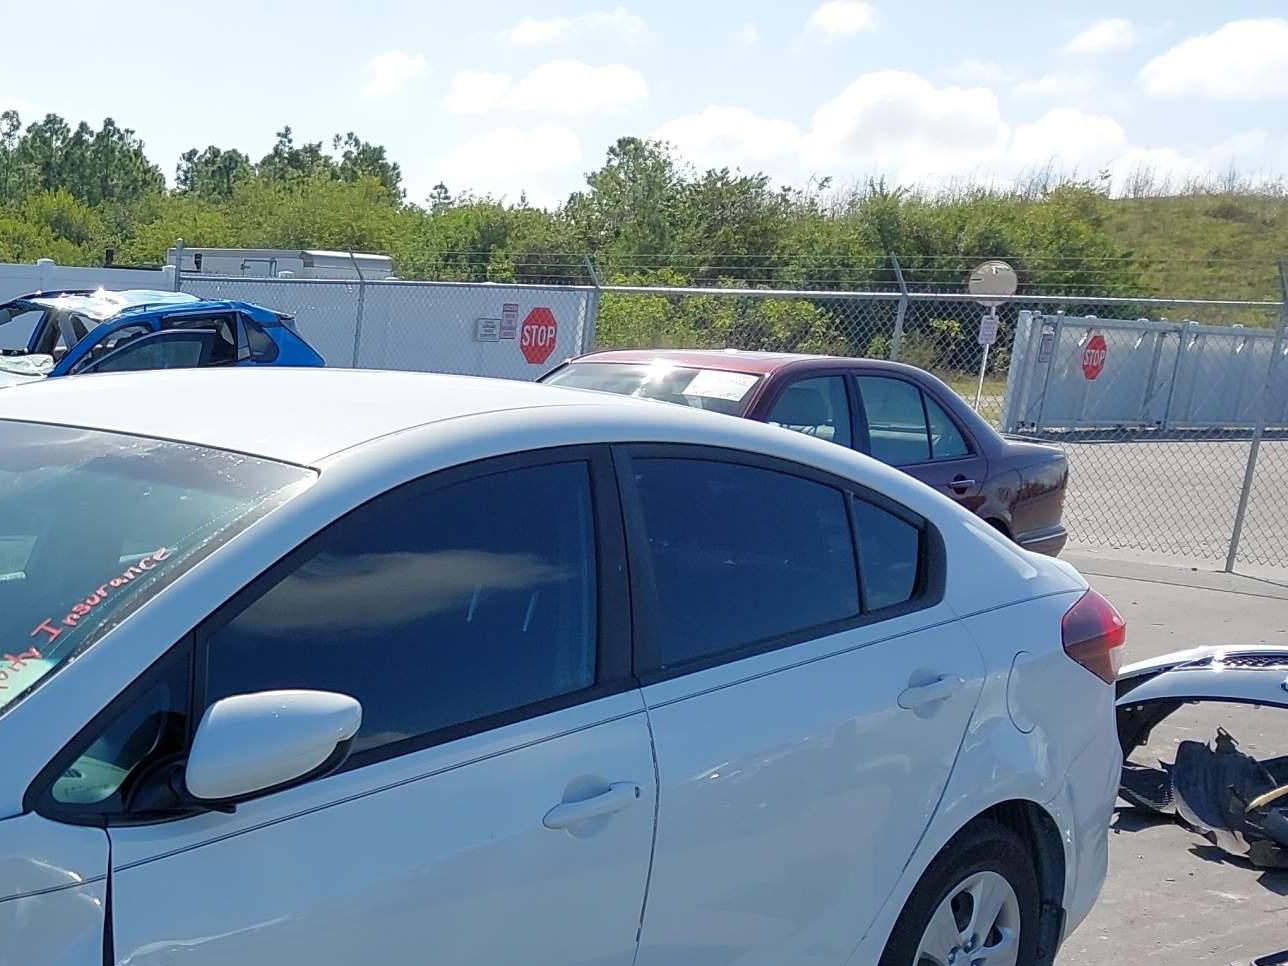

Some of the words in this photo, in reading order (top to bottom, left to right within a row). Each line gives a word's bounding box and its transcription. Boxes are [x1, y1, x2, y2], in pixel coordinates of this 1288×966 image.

[522, 325, 556, 347] STOP
[1084, 349, 1107, 367] STOP
[30, 546, 171, 645] Insurance
